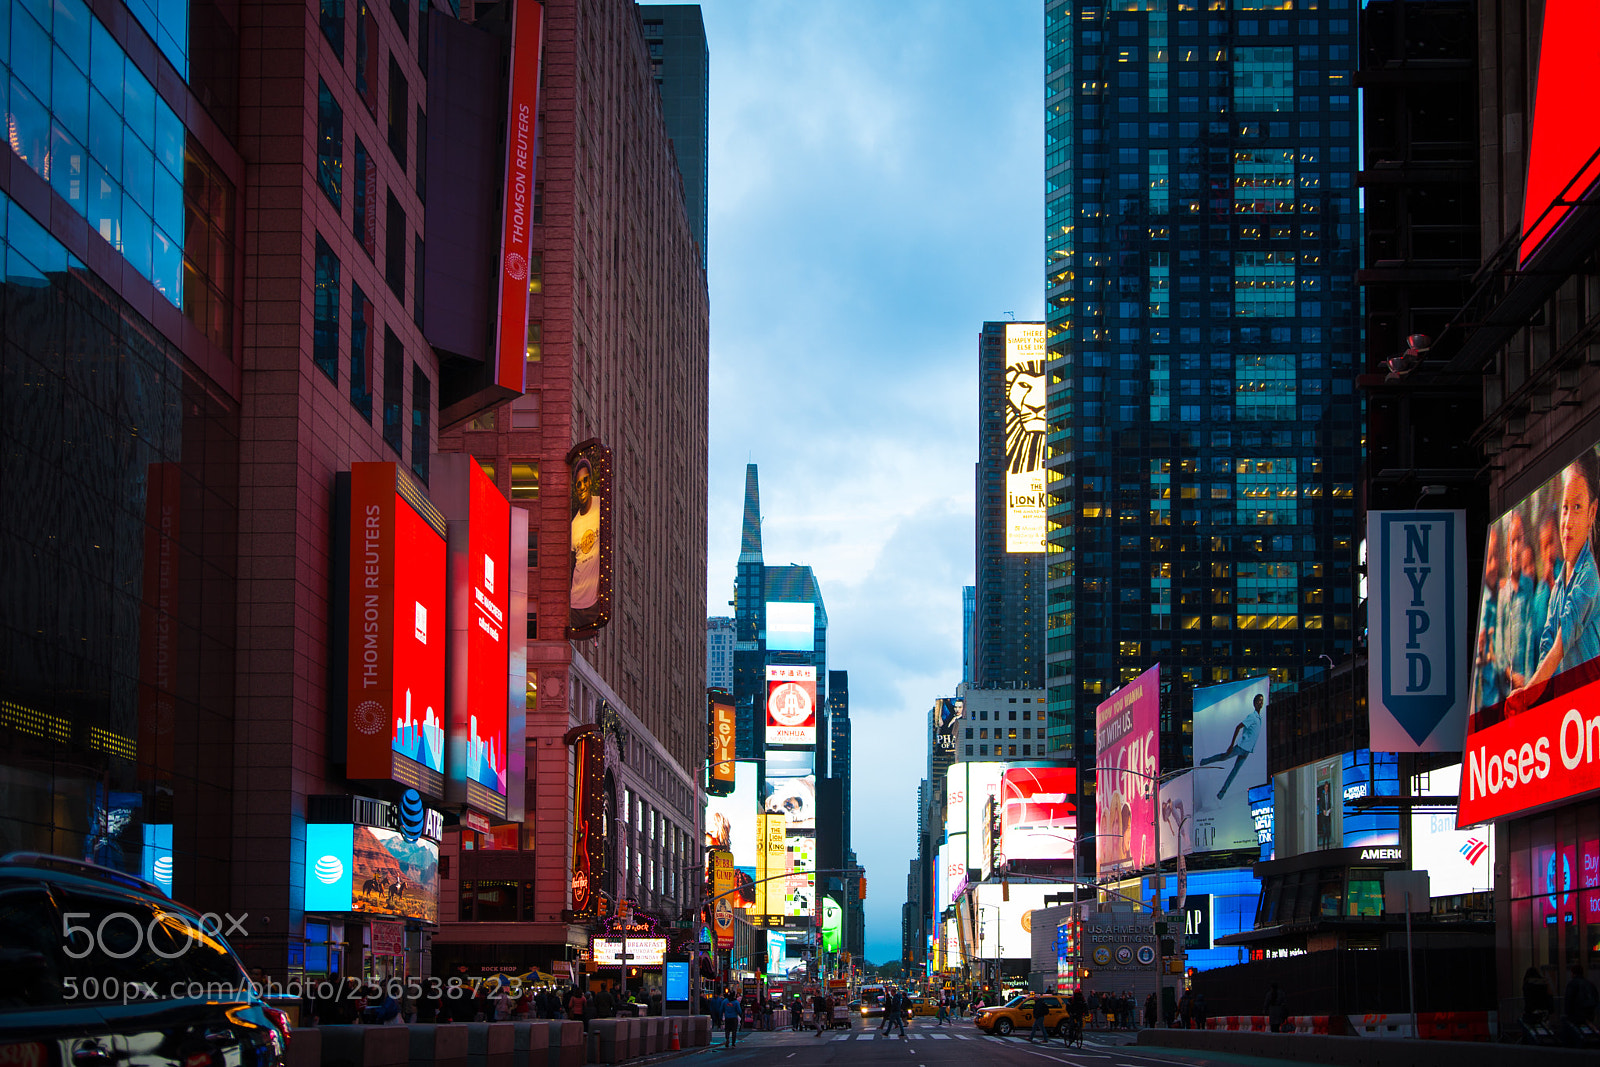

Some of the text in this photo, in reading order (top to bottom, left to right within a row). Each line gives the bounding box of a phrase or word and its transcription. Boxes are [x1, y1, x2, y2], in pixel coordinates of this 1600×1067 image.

[512, 104, 529, 244] THOMSON REUTERS
[364, 504, 380, 688] THOMSON REUTERS
[1404, 524, 1432, 692] NYPD
[1470, 736, 1550, 801] Noses
[1195, 827, 1216, 847] GAP
[716, 869, 732, 880] GUMP
[1092, 935, 1142, 944] RECRUITING
[1105, 924, 1142, 934] ARMED
